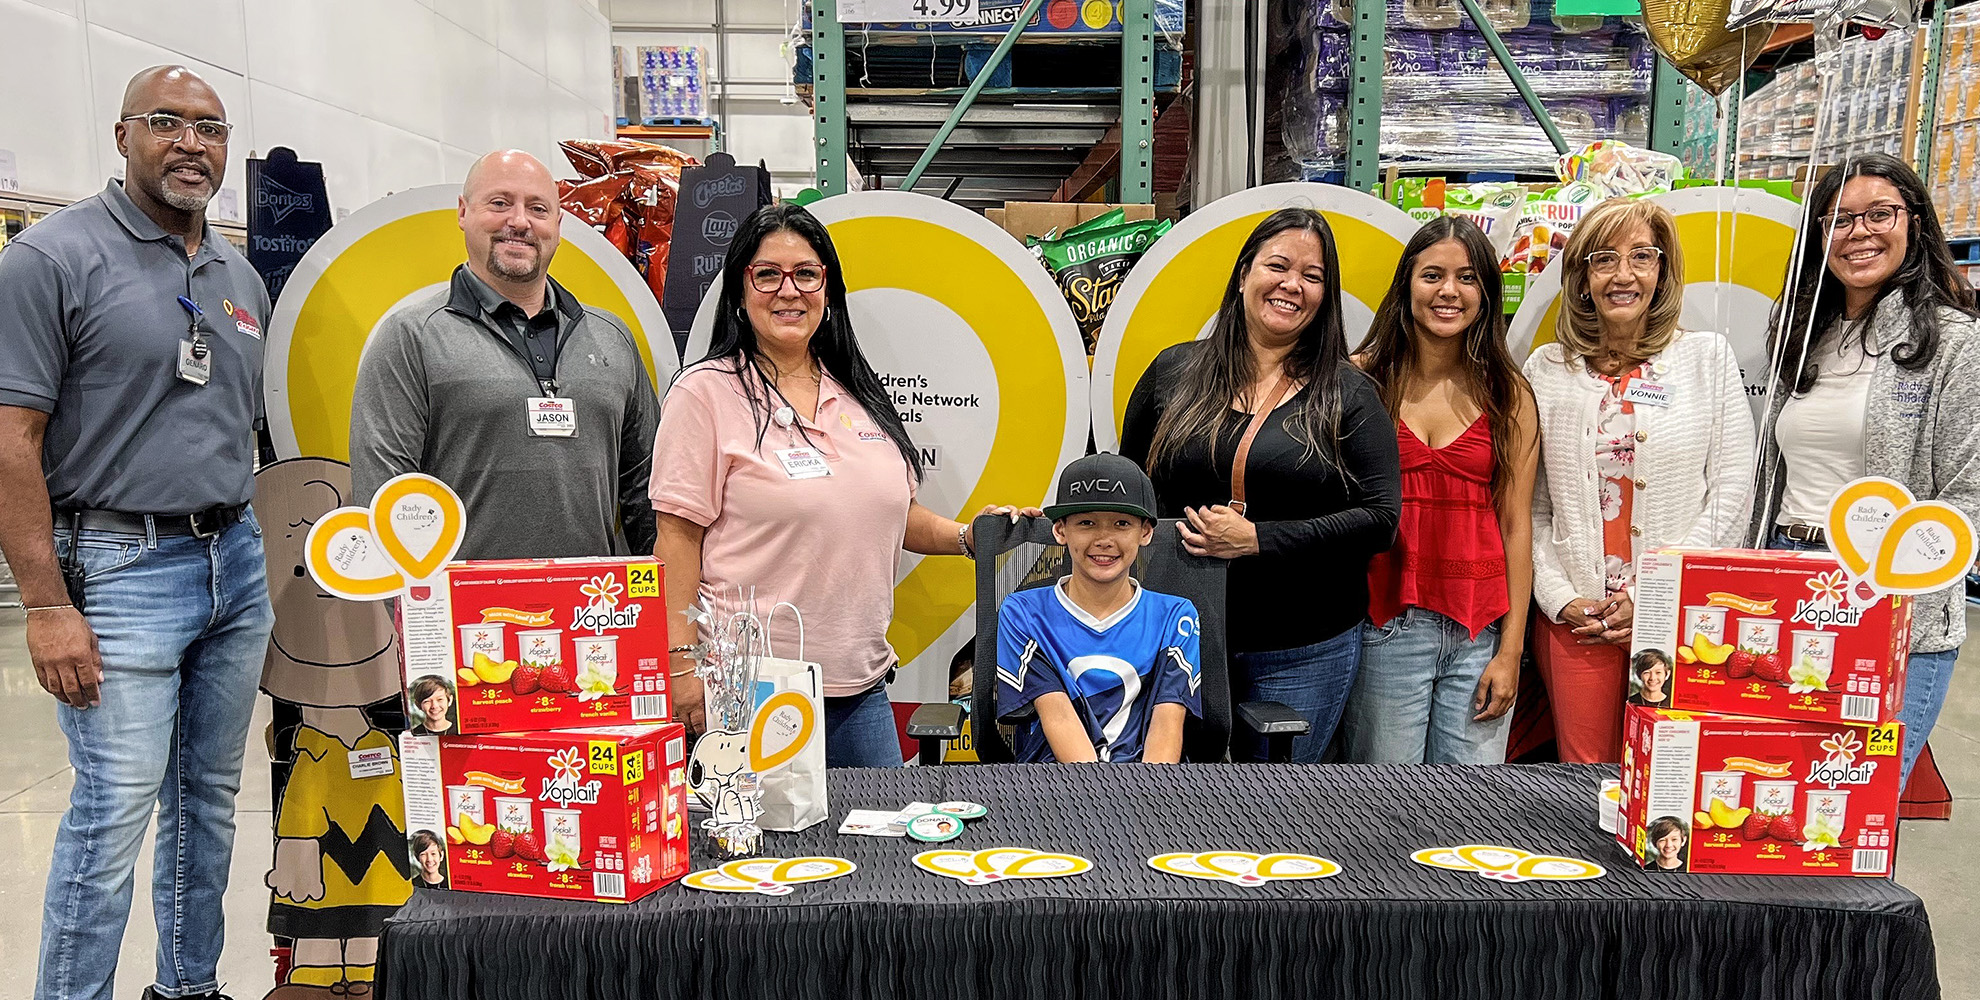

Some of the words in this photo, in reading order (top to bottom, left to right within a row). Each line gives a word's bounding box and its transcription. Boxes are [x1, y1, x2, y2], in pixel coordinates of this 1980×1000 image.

[913, 0, 971, 16] 4.99
[952, 7, 1021, 26] NNECT
[695, 177, 744, 203] Cheetos
[257, 191, 311, 207] Doritos
[1411, 211, 1437, 220] 100%
[1067, 235, 1134, 262] ORGANIC
[876, 373, 928, 388] dren's
[912, 391, 980, 408] Network
[1630, 389, 1669, 402] VONNIE
[536, 413, 570, 423] JASON
[897, 409, 923, 423] als
[787, 459, 821, 469] ERICKA
[402, 504, 421, 513] Rady
[1857, 506, 1878, 515] Rady
[1925, 527, 1942, 544] Rady
[334, 544, 349, 562] Rady
[630, 569, 655, 585] 24
[630, 585, 656, 594] CUPS
[572, 607, 637, 633] Yoplait
[1793, 602, 1859, 628] Yoplait
[1702, 669, 1710, 679] 8
[487, 689, 496, 698] 8
[1752, 683, 1760, 693] 8
[541, 697, 549, 706] 8
[1804, 695, 1812, 705] 8
[595, 702, 603, 711] 8
[1870, 729, 1895, 743] 24
[591, 746, 614, 761] 24
[591, 762, 615, 771] CUPS
[627, 755, 636, 780] 24
[1808, 763, 1871, 787] Yoplait
[541, 781, 597, 806] Yoplait
[1719, 833, 1726, 843] 8
[1768, 843, 1775, 852] 8
[471, 850, 478, 859] 8
[1818, 852, 1825, 862] 8
[515, 863, 523, 871] 8
[562, 873, 568, 883] 8
